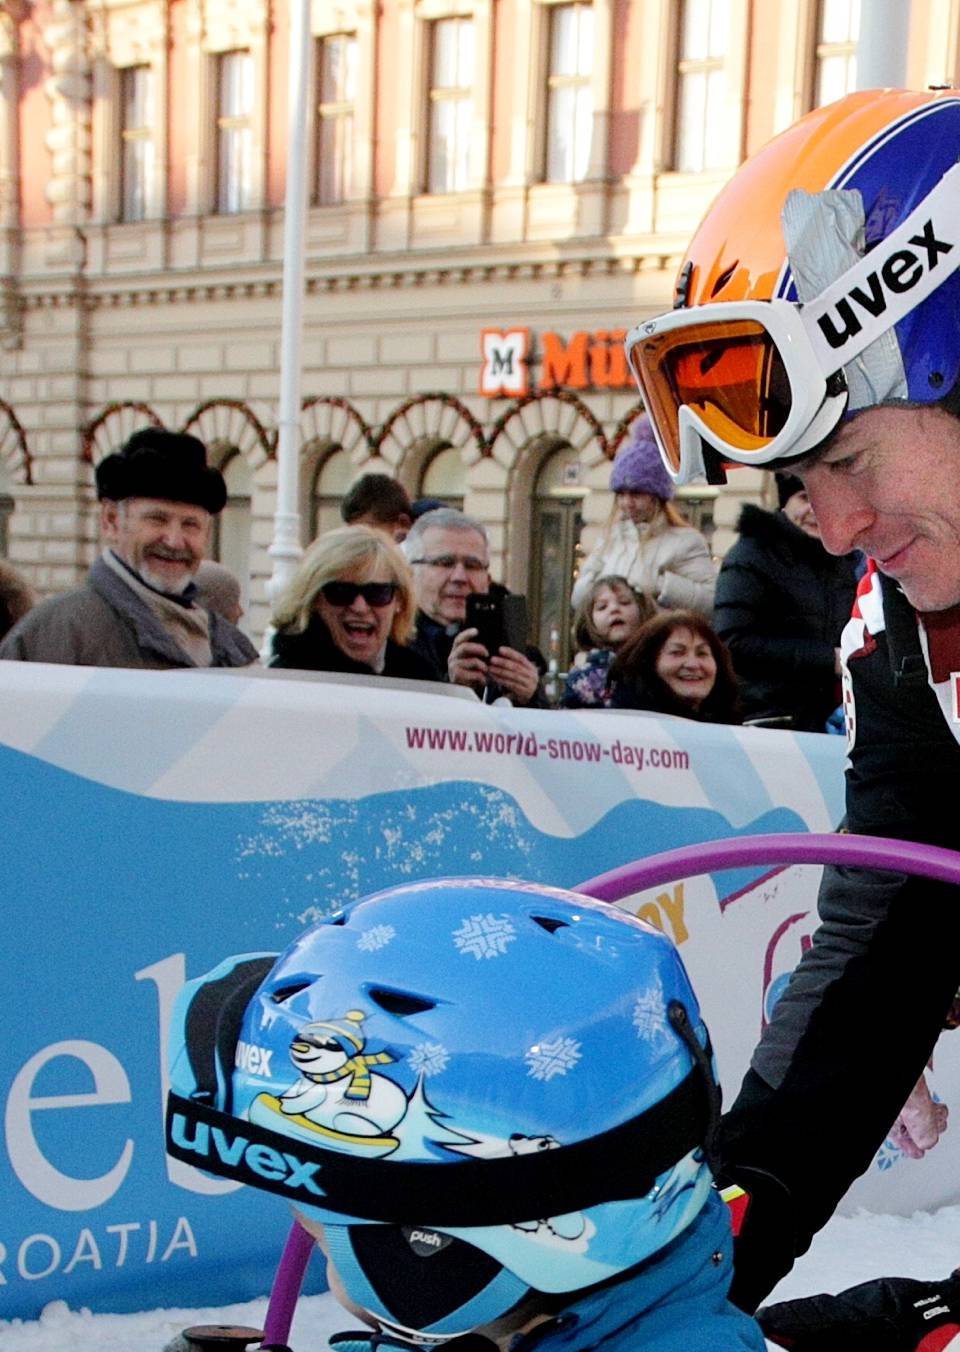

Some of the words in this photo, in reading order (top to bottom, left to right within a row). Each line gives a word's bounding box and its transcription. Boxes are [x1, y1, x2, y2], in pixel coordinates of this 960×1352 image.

[817, 218, 954, 349] uvex
[539, 328, 637, 389] Mü
[405, 726, 690, 770] www.world-snow-day.com
[171, 1113, 328, 1197] uvex
[0, 1216, 198, 1286] OATIA
[409, 1230, 441, 1247] push
